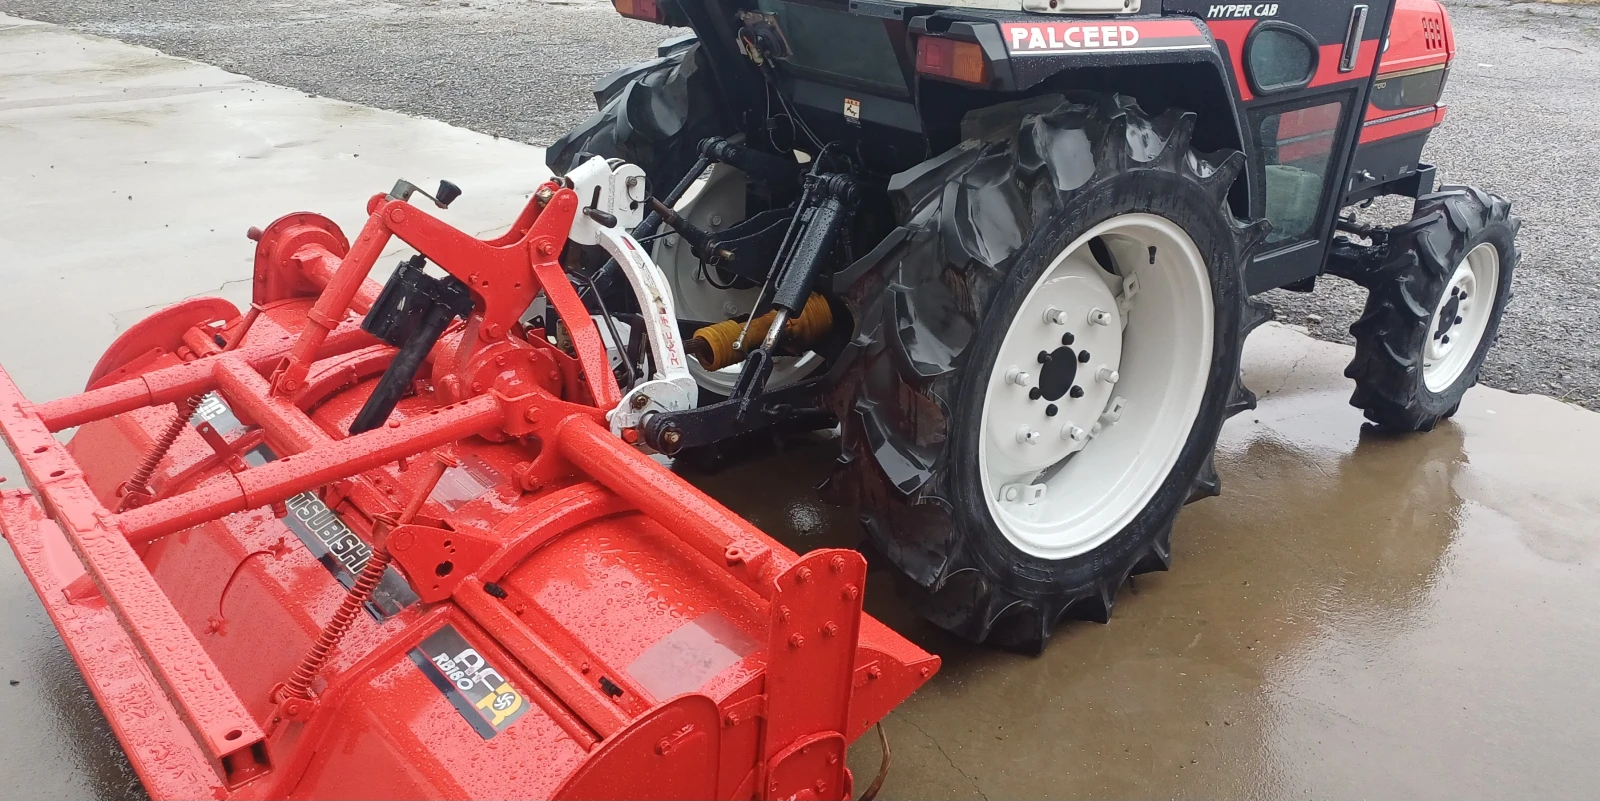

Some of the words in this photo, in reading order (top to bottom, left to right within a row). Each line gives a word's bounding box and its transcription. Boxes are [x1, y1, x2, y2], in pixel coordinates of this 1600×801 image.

[1207, 4, 1252, 18] HYPER
[1253, 3, 1279, 17] CAB
[1010, 26, 1139, 49] PALCEED
[432, 652, 474, 690] RB180
